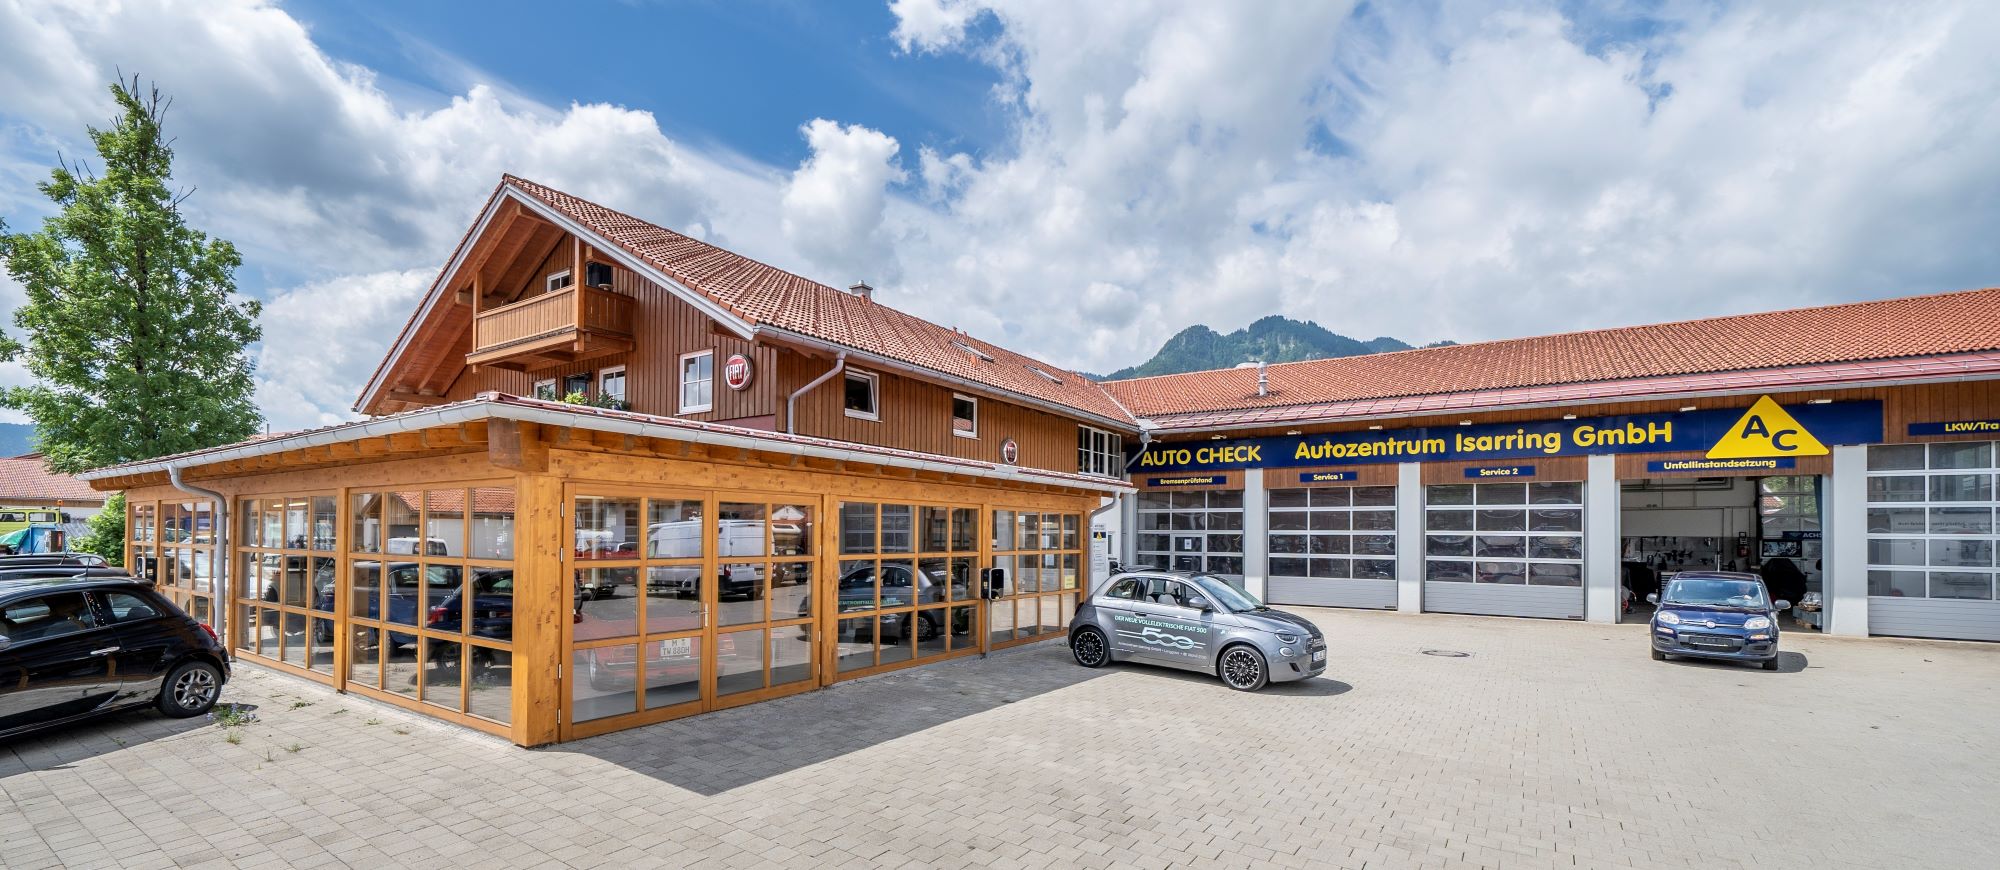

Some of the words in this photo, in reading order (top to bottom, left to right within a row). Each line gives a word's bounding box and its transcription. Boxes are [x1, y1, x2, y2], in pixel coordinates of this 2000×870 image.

[729, 363, 744, 381] FIAT
[1294, 437, 1446, 460] Autozentrum
[1455, 428, 1562, 454] Isarring
[1572, 421, 1673, 448] GmbH
[1140, 448, 1191, 467] AUTO
[1196, 445, 1262, 464] CHECK
[1663, 459, 1777, 469] Unfallinstandsetzung
[1480, 468, 1510, 476] Service
[1512, 467, 1518, 475] 2
[1160, 477, 1212, 485] Bremsenprüfstand
[1138, 618, 1184, 629] VOLLELEKTRISCHE
